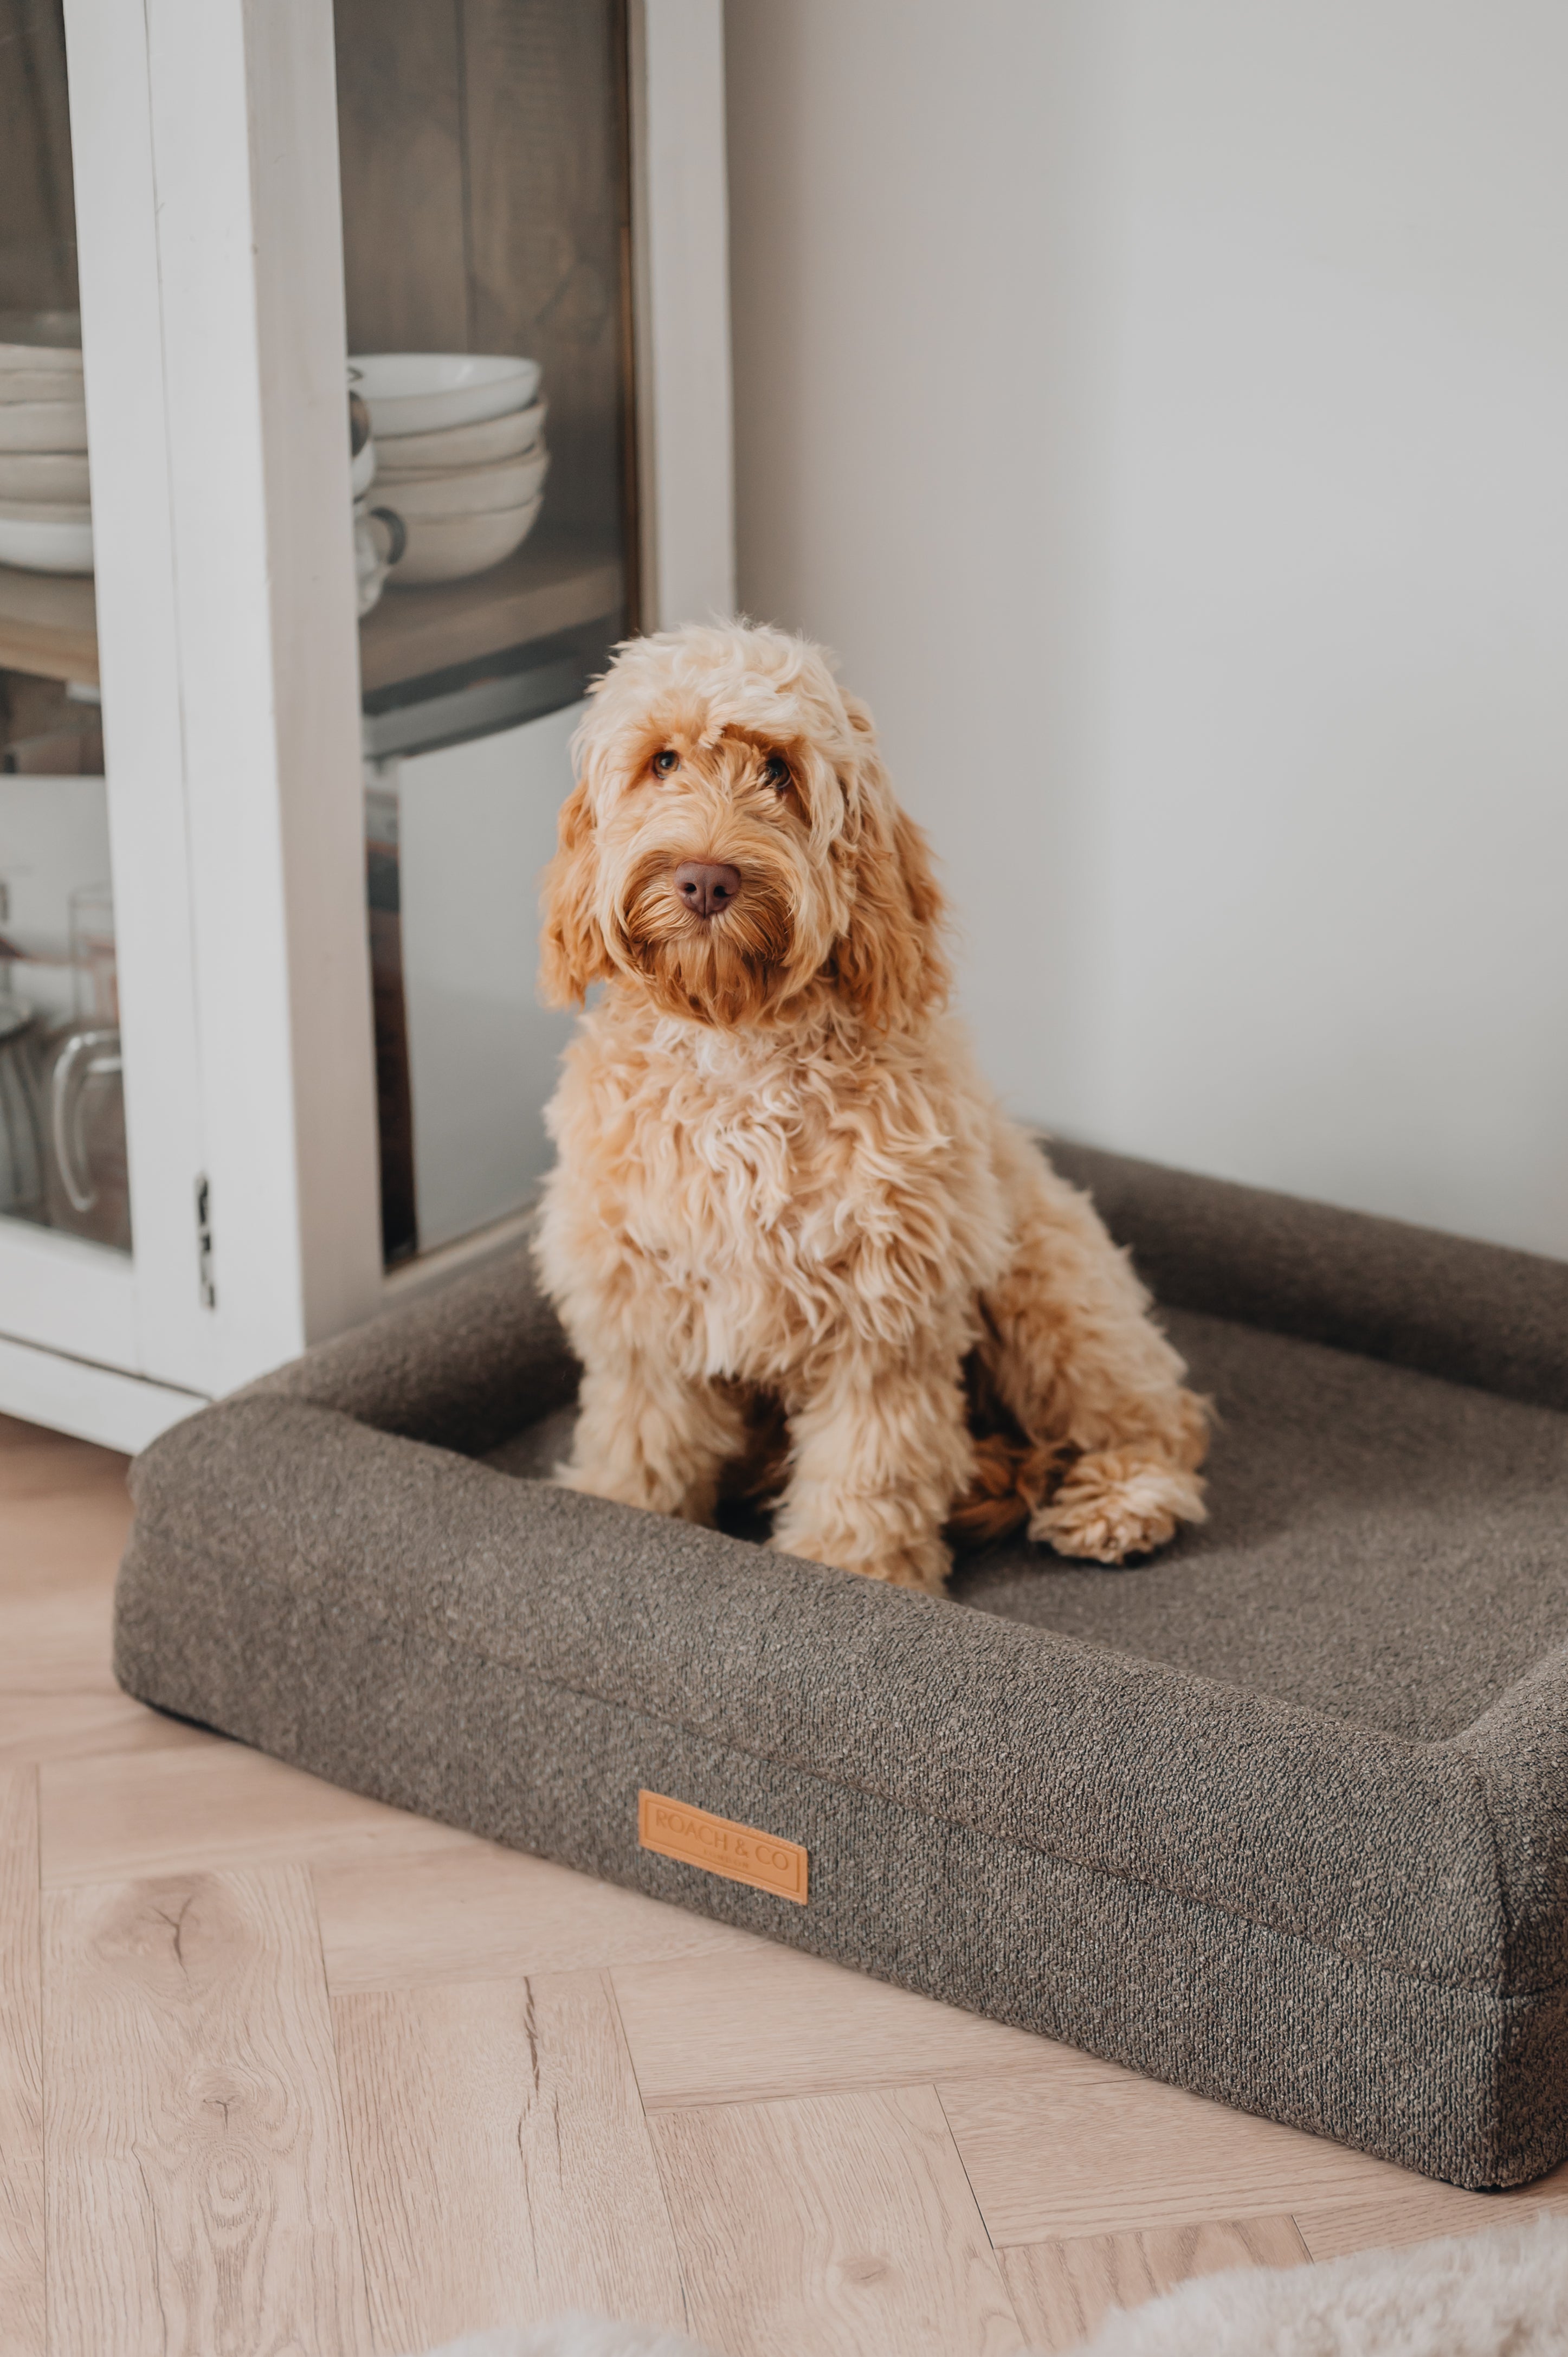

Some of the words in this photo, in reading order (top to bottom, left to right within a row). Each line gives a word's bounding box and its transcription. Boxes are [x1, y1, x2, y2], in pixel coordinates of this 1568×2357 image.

[656, 1809, 727, 1851] ROACH
[735, 1838, 749, 1858] &
[756, 1845, 789, 1871] CO
